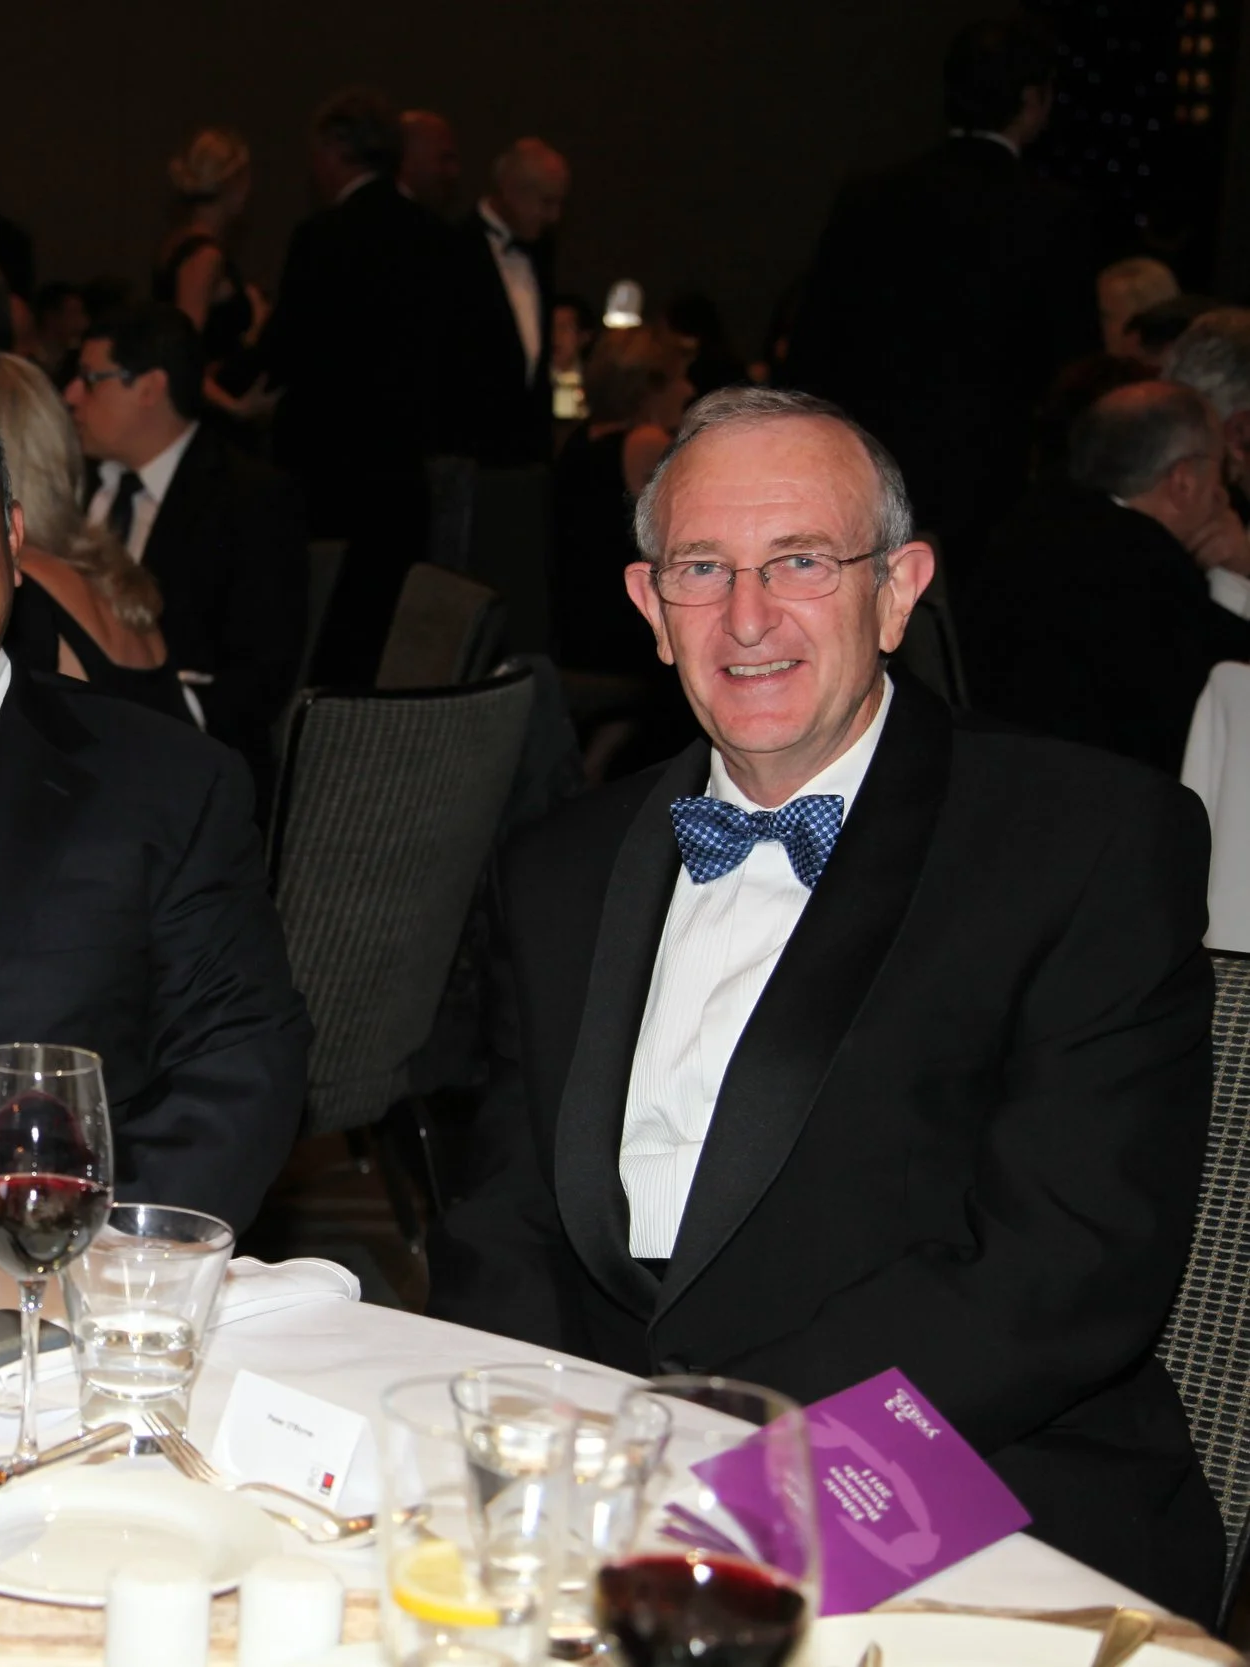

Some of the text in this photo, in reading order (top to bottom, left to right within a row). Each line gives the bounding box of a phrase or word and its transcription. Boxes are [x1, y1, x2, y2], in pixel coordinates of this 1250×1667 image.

[823, 1478, 865, 1521] Ethnic
[829, 1466, 881, 1522] Business
[843, 1465, 889, 1510] Awards
[861, 1468, 893, 1499] 2011
